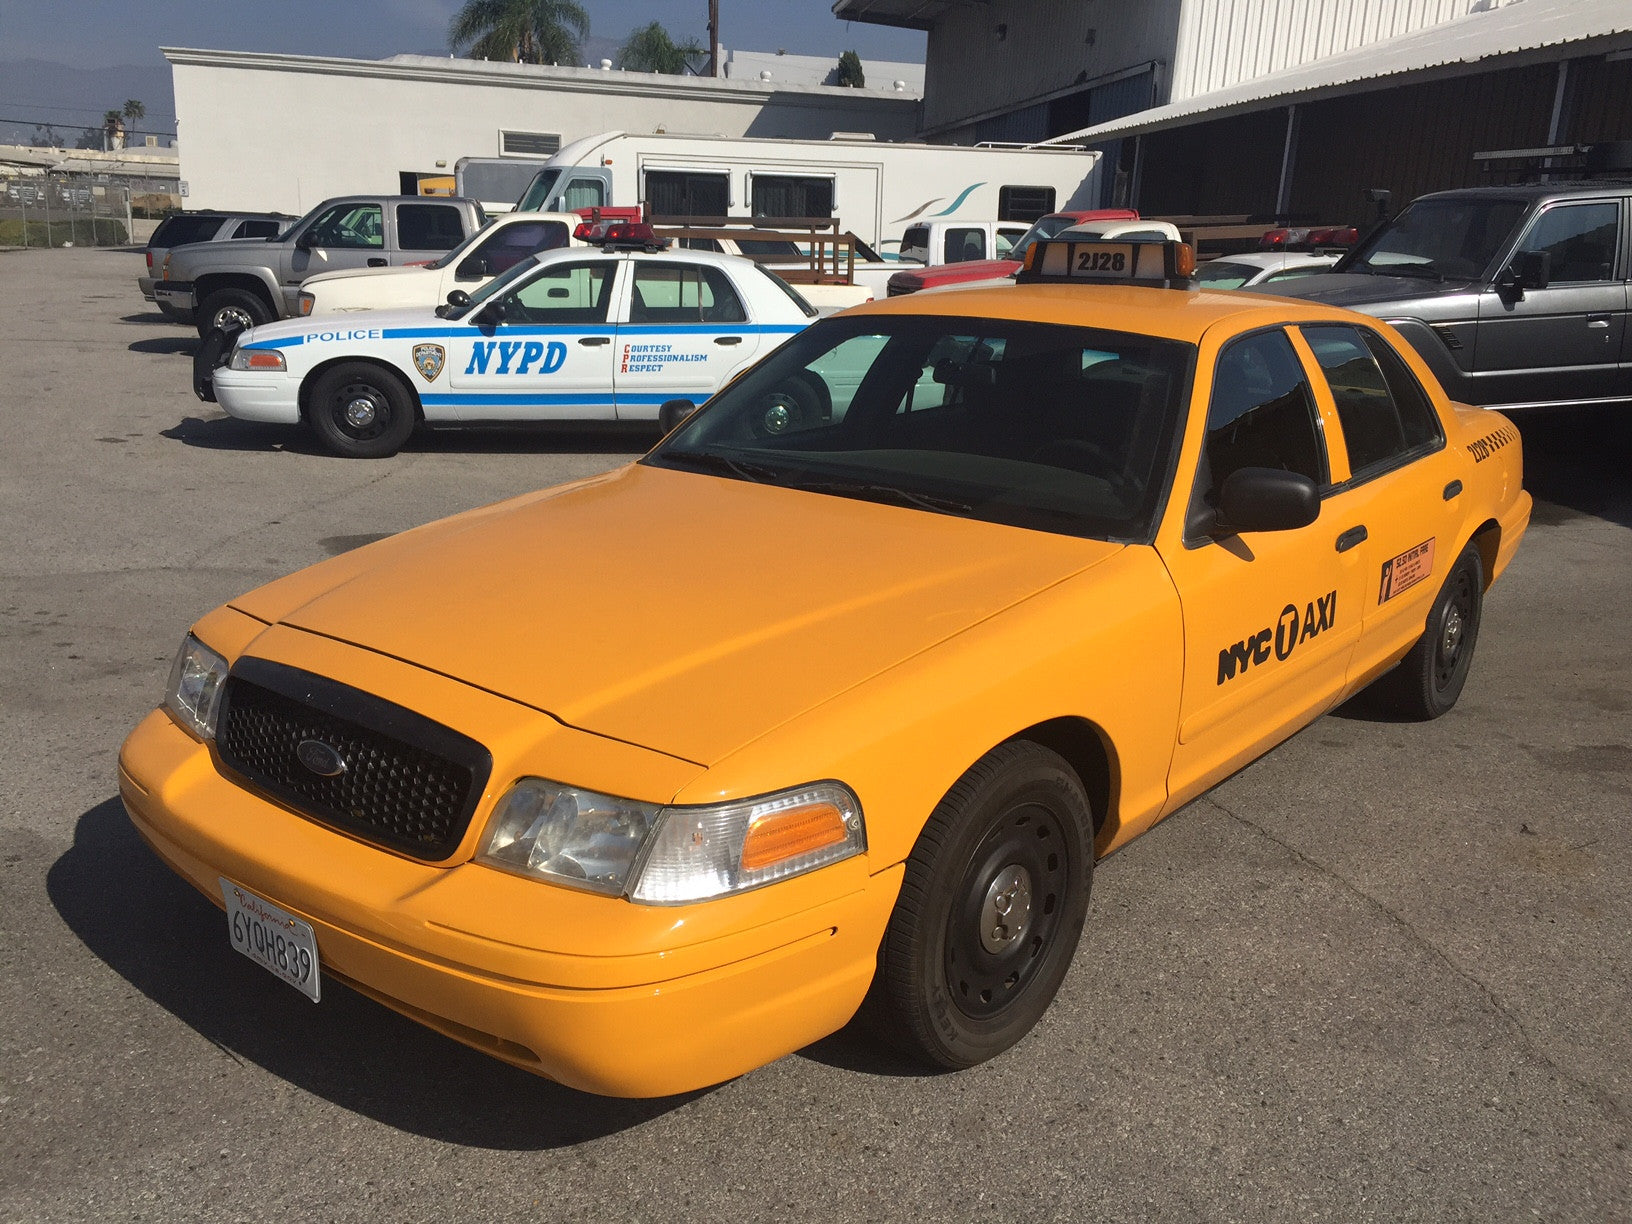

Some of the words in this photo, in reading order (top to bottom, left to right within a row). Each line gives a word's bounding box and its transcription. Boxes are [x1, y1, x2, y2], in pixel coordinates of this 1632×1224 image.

[306, 329, 380, 343] POLICE
[464, 341, 568, 375] NYPD
[623, 354, 708, 363] PROFESSIONALISM
[624, 344, 673, 354] COURTESY
[621, 364, 663, 373] RESPECT
[1217, 627, 1273, 686] NYC
[240, 893, 298, 937] California
[233, 910, 311, 984] 6YQH839
